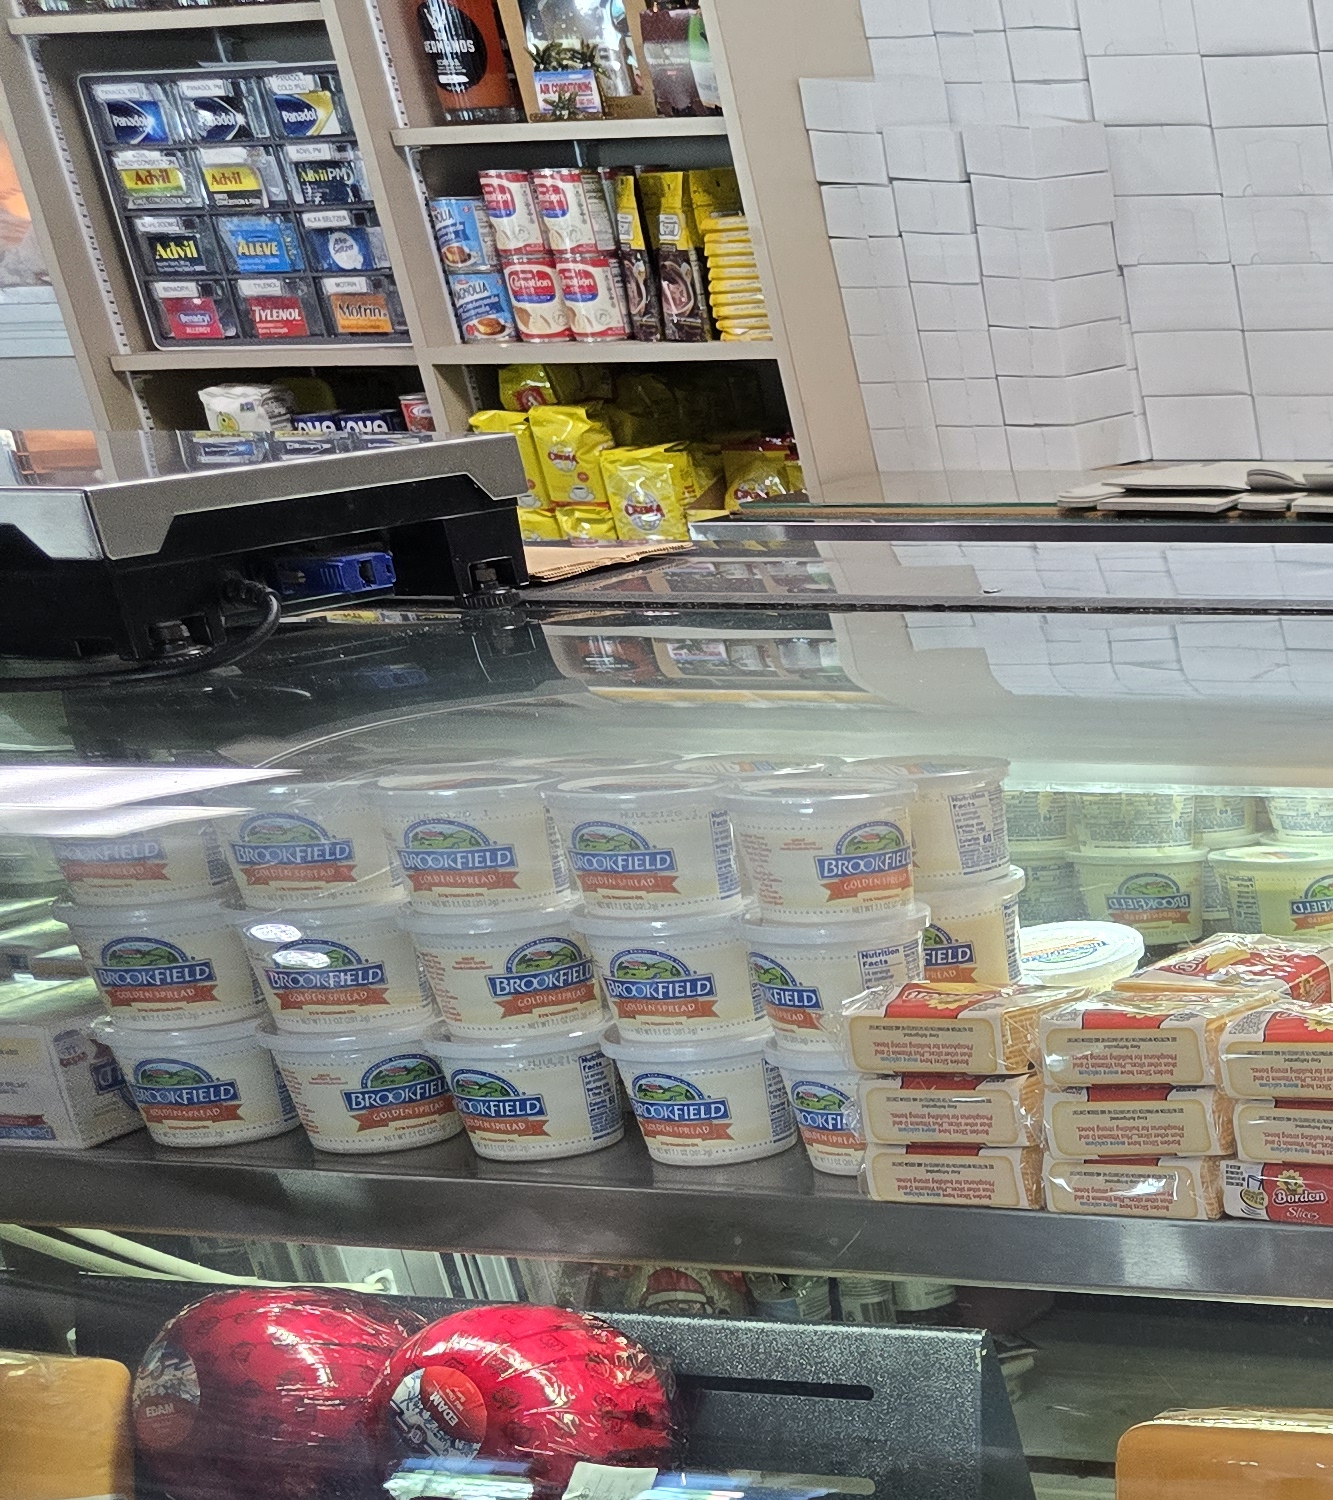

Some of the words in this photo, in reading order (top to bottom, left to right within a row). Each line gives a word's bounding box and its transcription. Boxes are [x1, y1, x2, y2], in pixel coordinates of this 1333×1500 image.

[282, 108, 316, 124] Panadol
[134, 169, 172, 185] Advil
[211, 172, 243, 185] Advil
[328, 167, 348, 181] PM
[155, 240, 198, 259] Advil
[237, 240, 280, 256] ALEVE
[252, 306, 301, 322] TYLENOL
[339, 303, 382, 318] Motrin
[236, 843, 350, 865] BROOKFIELD
[401, 851, 511, 870] BROOKFIELD
[573, 852, 671, 872] BROOKFIELD
[861, 948, 900, 961] Nutrition
[862, 957, 888, 968] Facts
[101, 967, 210, 987] BROOKFIELD
[271, 966, 382, 989] BROOKFIELD
[494, 963, 592, 994] BROOKFIELD
[608, 978, 713, 998] BROOKFIELD
[664, 1001, 695, 1013] SPREAD
[1274, 1189, 1325, 1204] Borden
[1286, 1207, 1319, 1219] Slices
[146, 1403, 175, 1418] EDAM
[429, 1392, 459, 1427] EDAM
